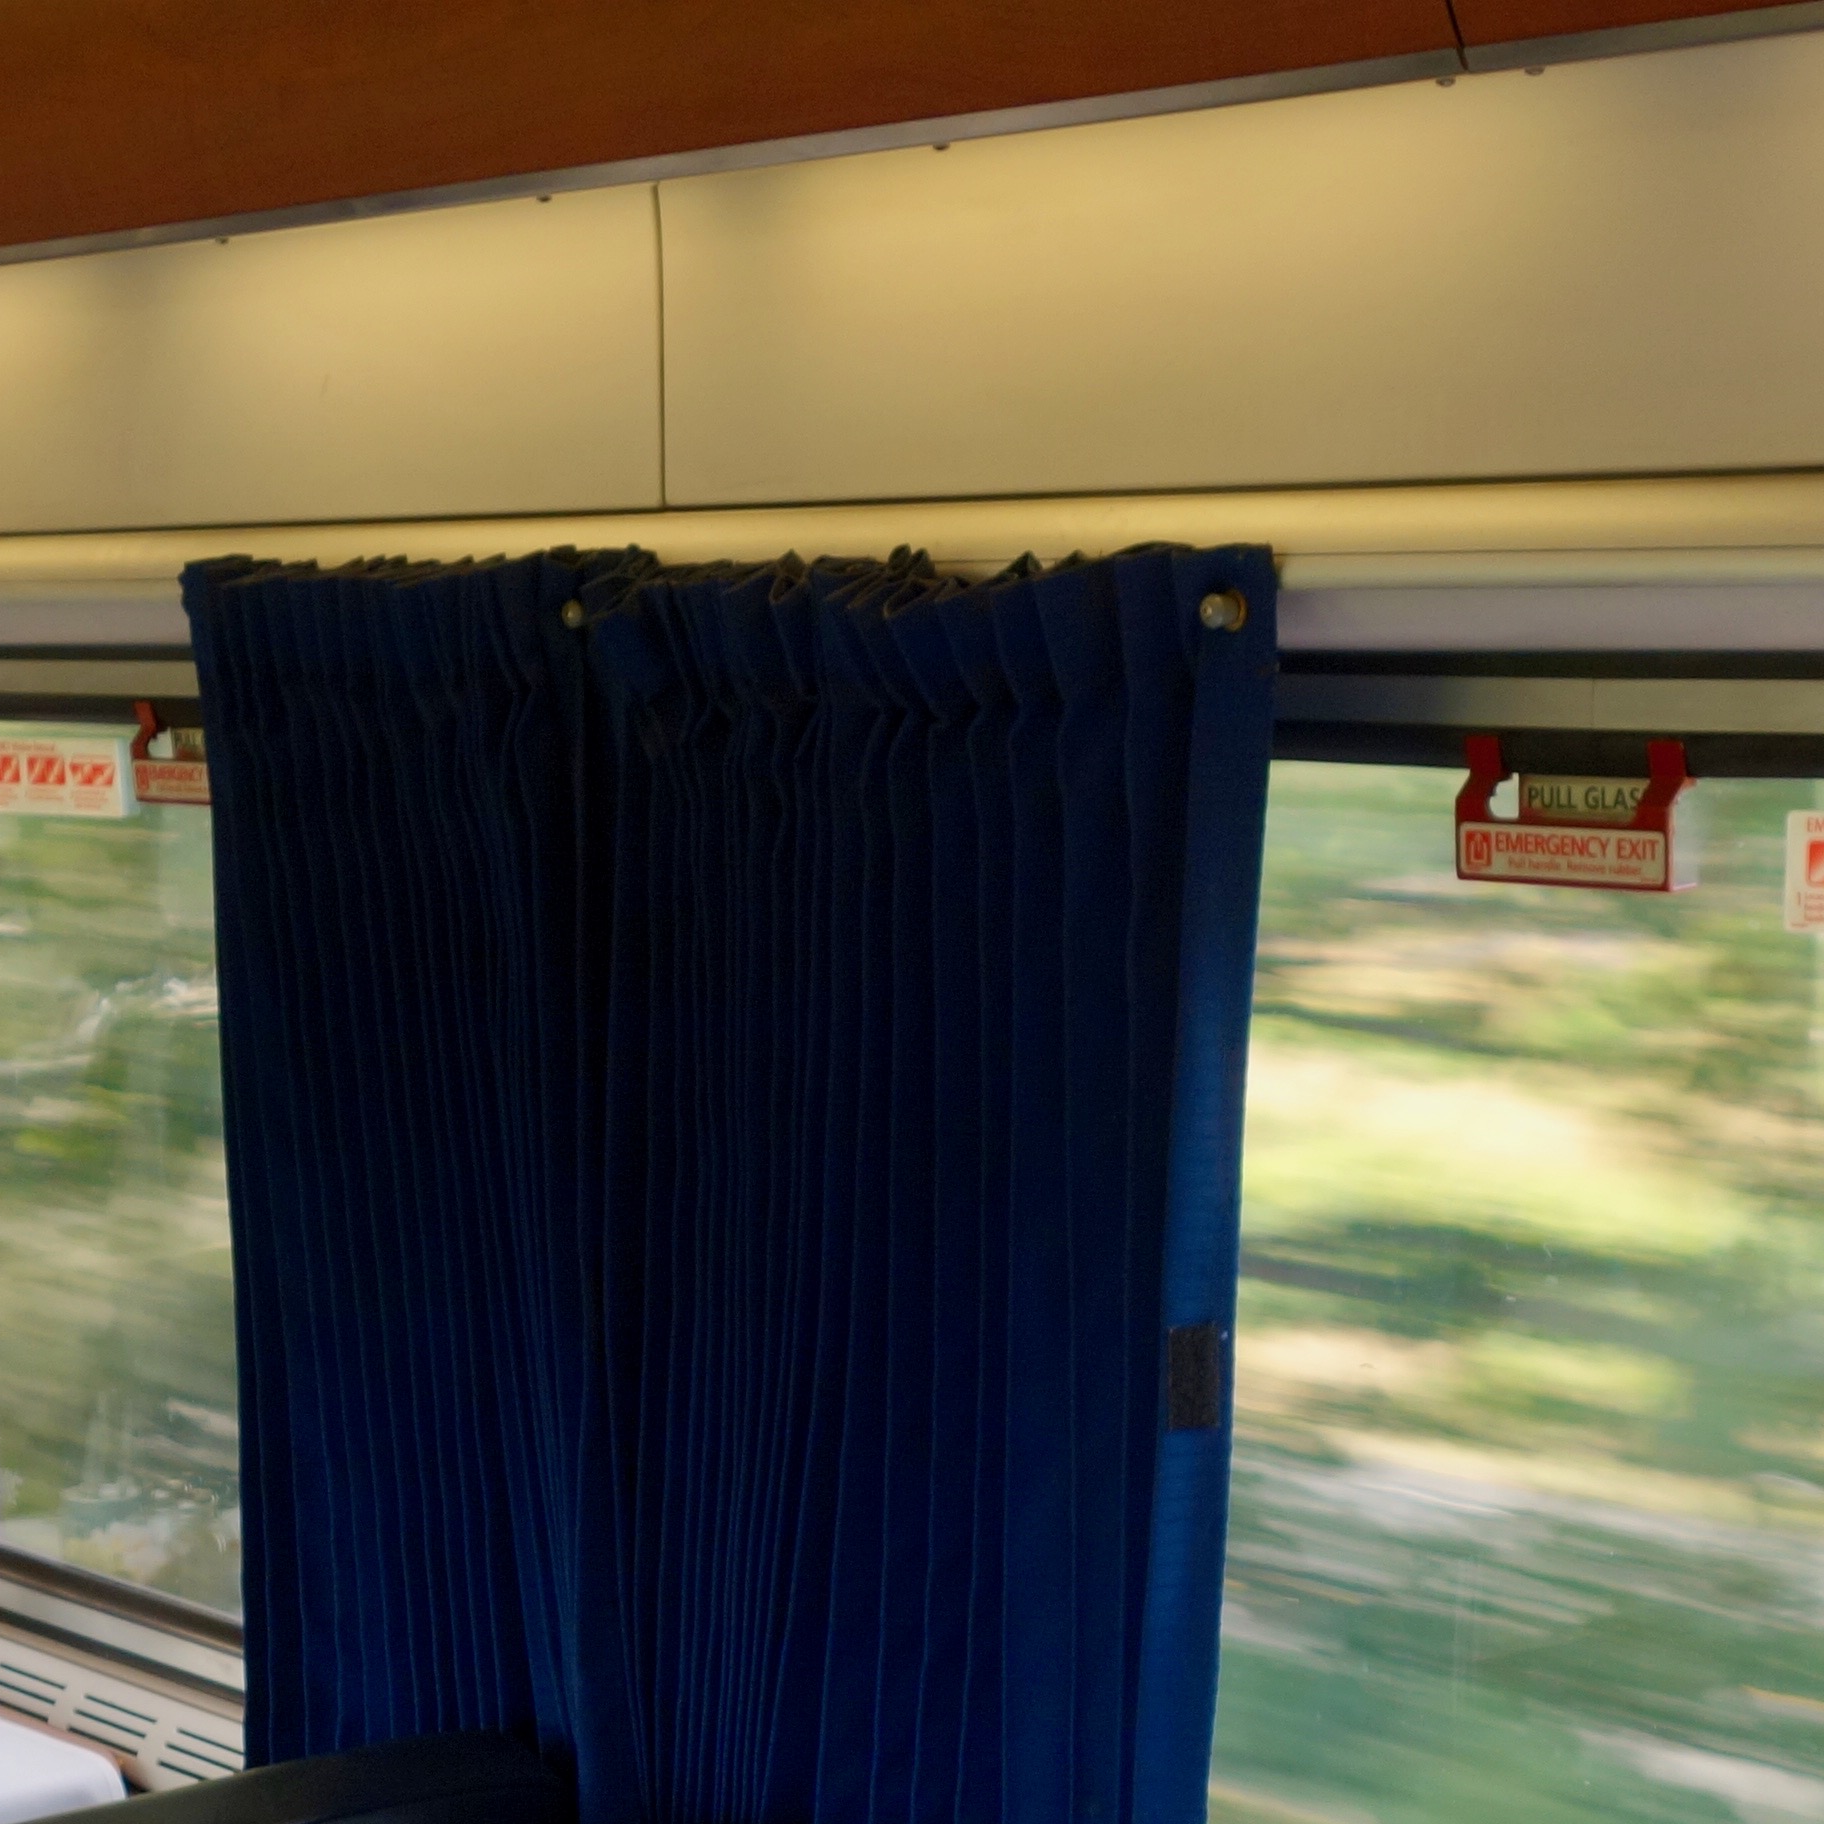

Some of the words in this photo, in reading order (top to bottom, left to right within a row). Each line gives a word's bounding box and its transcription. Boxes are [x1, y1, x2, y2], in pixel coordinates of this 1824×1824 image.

[1528, 786, 1576, 809] PULL
[1495, 831, 1610, 858] EMERGENCY
[1617, 839, 1659, 860] EXIT
